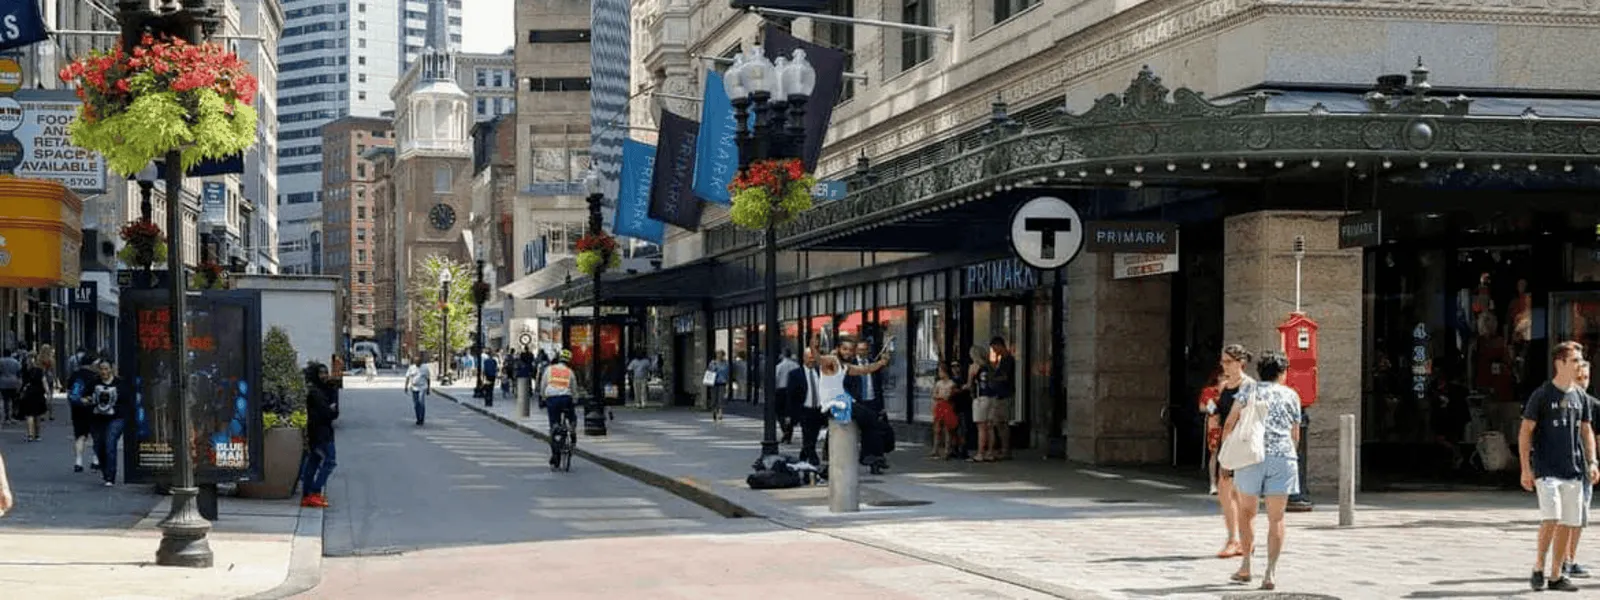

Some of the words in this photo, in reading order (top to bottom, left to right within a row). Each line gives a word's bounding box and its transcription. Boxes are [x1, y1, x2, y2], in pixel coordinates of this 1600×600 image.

[0, 14, 19, 42] S
[34, 137, 72, 147] RETA
[34, 149, 87, 159] SPACE
[709, 109, 738, 196] RIMARK
[21, 162, 98, 172] AVAILABLE
[664, 131, 696, 215] PRIMARK
[630, 155, 656, 230] PRIMARK
[1025, 218, 1071, 259] T
[1097, 231, 1166, 243] PRIMARK
[967, 258, 1037, 293] PRIMARK
[216, 442, 244, 451] BLUE
[216, 451, 245, 461] MAN
